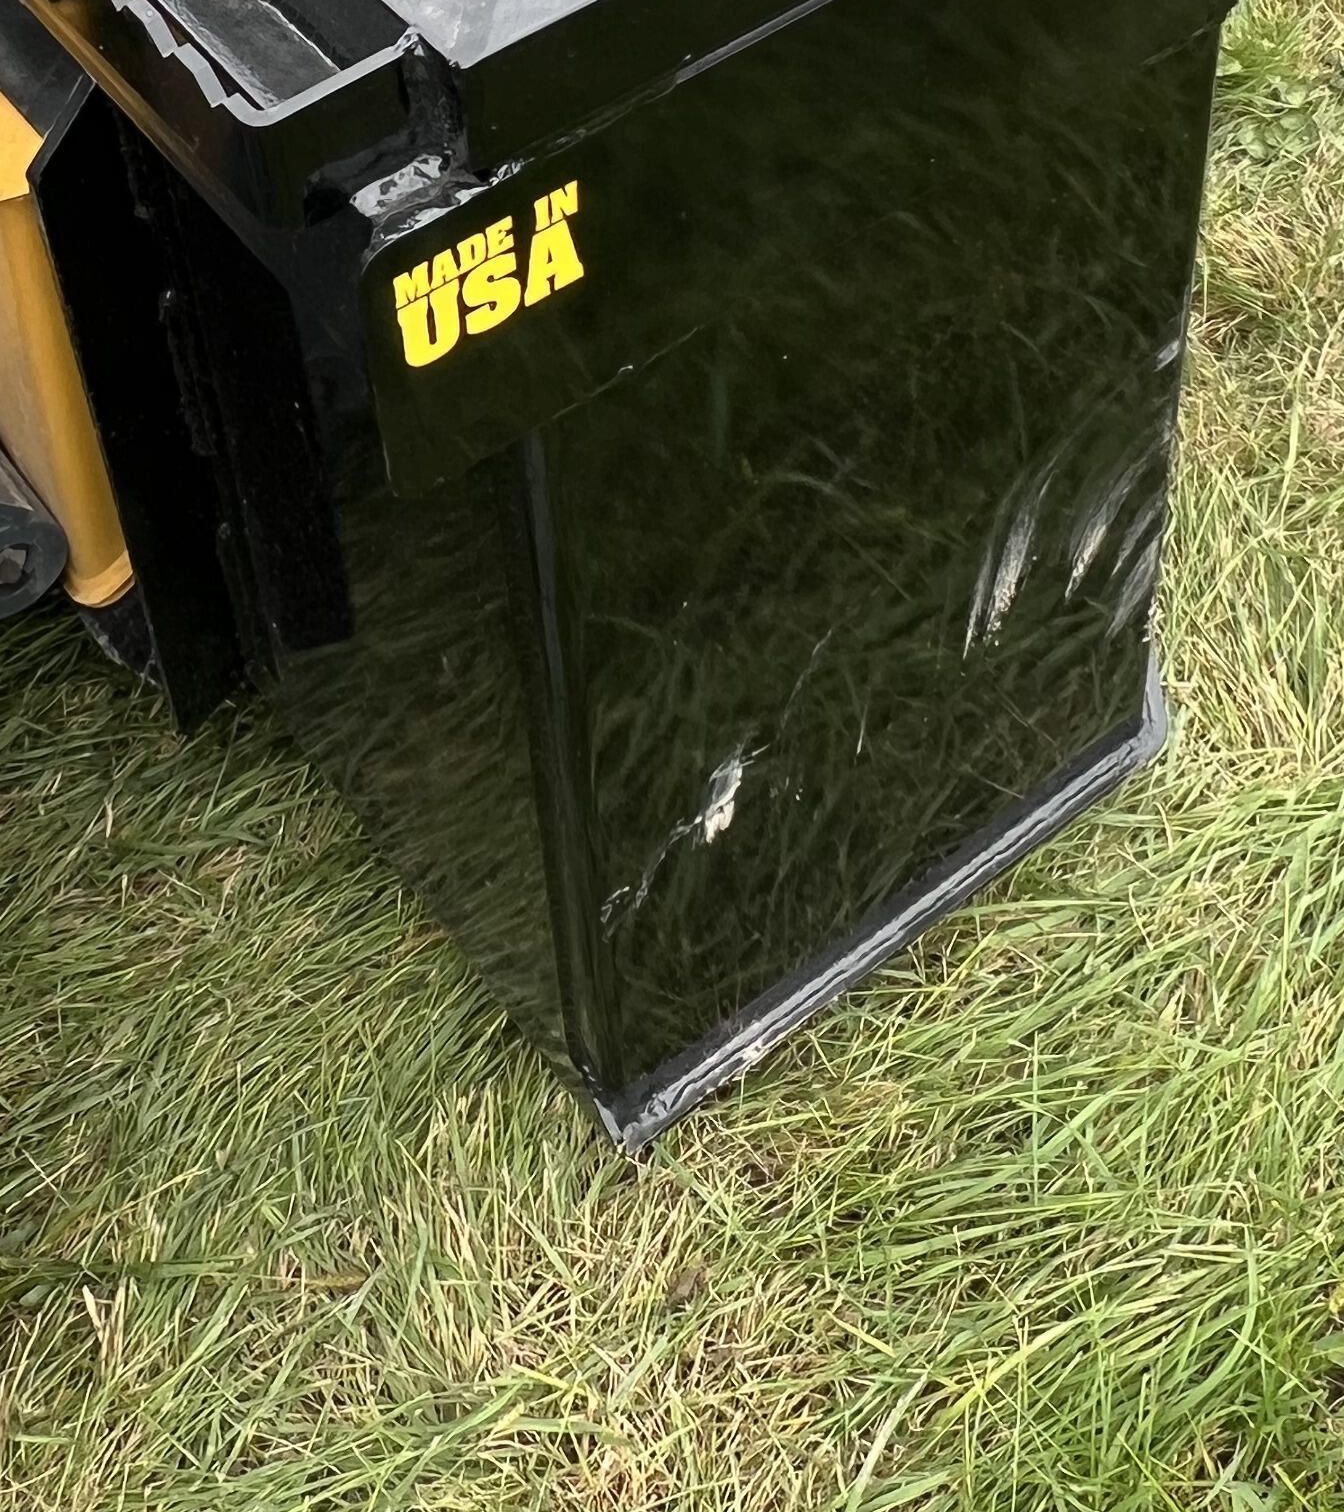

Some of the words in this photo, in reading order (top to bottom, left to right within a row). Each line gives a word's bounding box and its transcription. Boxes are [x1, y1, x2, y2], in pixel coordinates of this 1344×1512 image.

[392, 215, 516, 310] MADE
[533, 179, 579, 232] IN
[396, 219, 585, 369] USA
